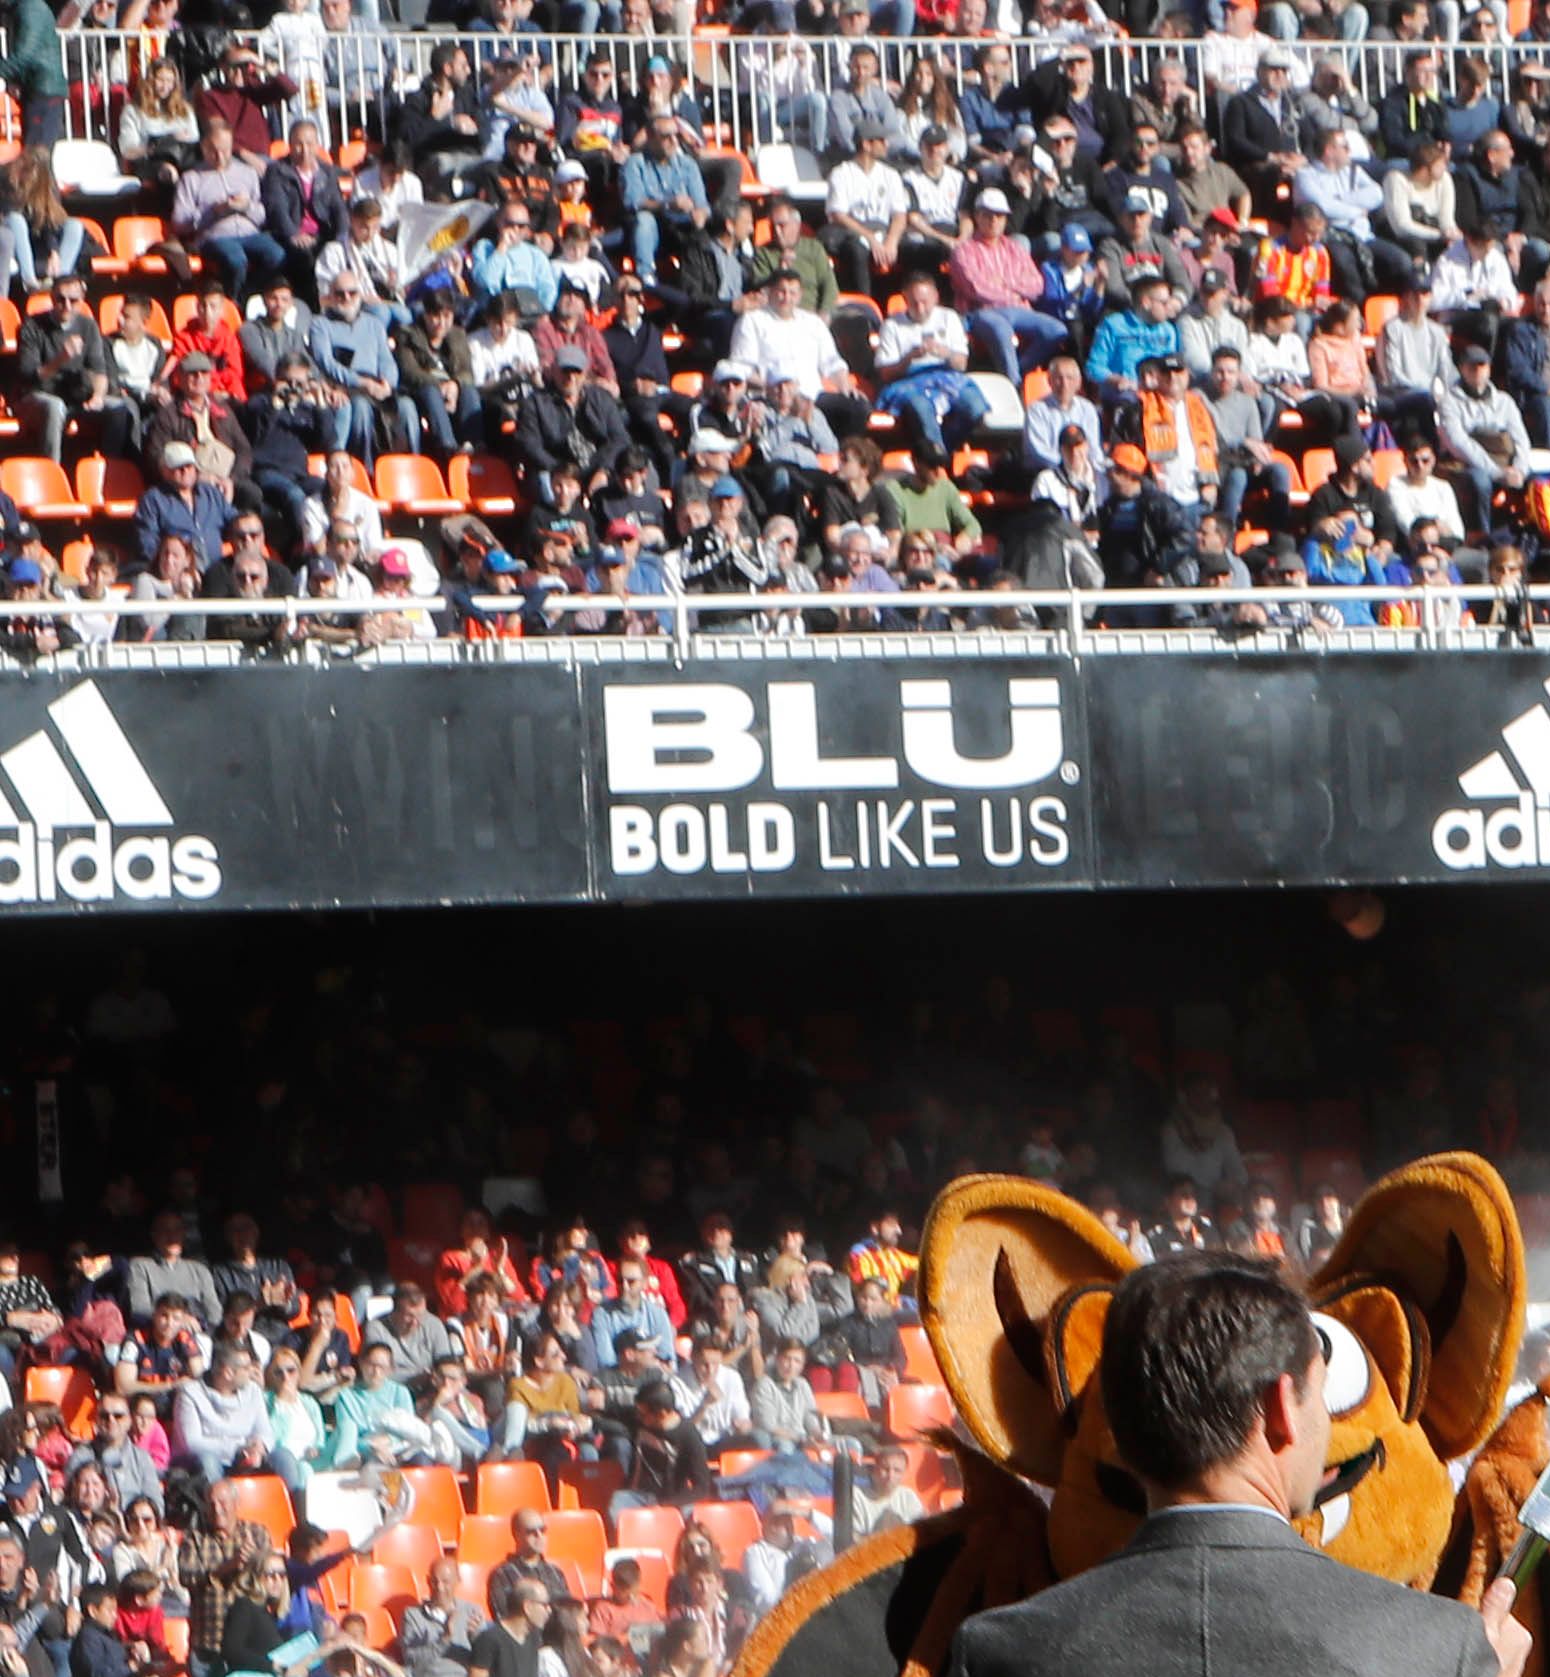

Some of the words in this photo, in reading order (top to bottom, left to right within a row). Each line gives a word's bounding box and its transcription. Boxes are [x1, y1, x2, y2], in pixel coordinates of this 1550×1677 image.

[0, 820, 223, 903] didas
[608, 802, 796, 875] BOLD
[817, 799, 961, 871] LIKE
[981, 796, 1070, 868] US
